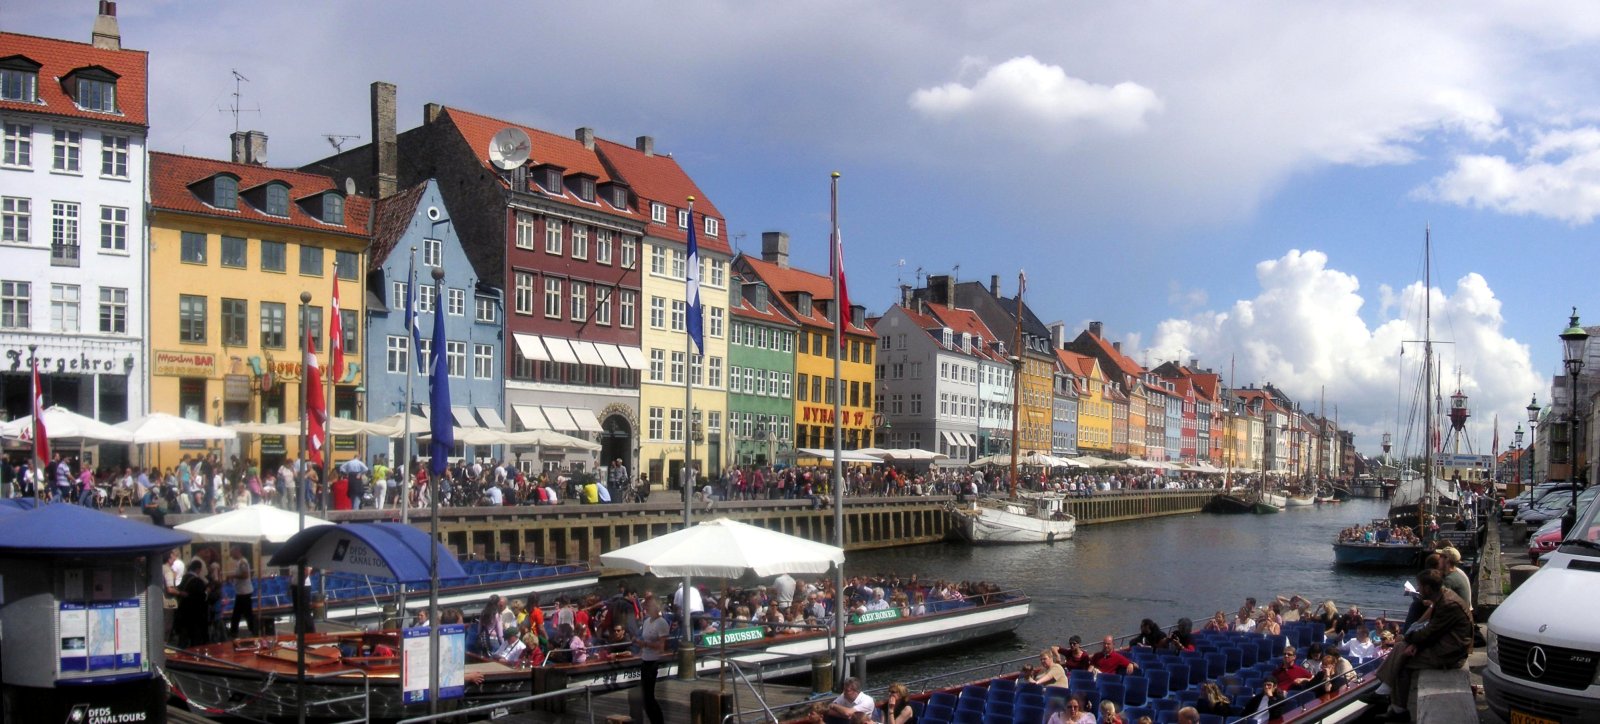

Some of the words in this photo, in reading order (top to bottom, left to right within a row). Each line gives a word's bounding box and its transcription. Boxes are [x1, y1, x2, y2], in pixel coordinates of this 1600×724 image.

[194, 355, 214, 367] BAR
[803, 406, 850, 426] NYHAN
[854, 411, 864, 427] 17
[350, 547, 368, 556] DFDS
[350, 555, 372, 566] CANAL
[372, 558, 388, 568] TOU
[88, 707, 111, 717] DFDS
[88, 714, 118, 724] CANAL
[118, 712, 146, 723] TOURS
